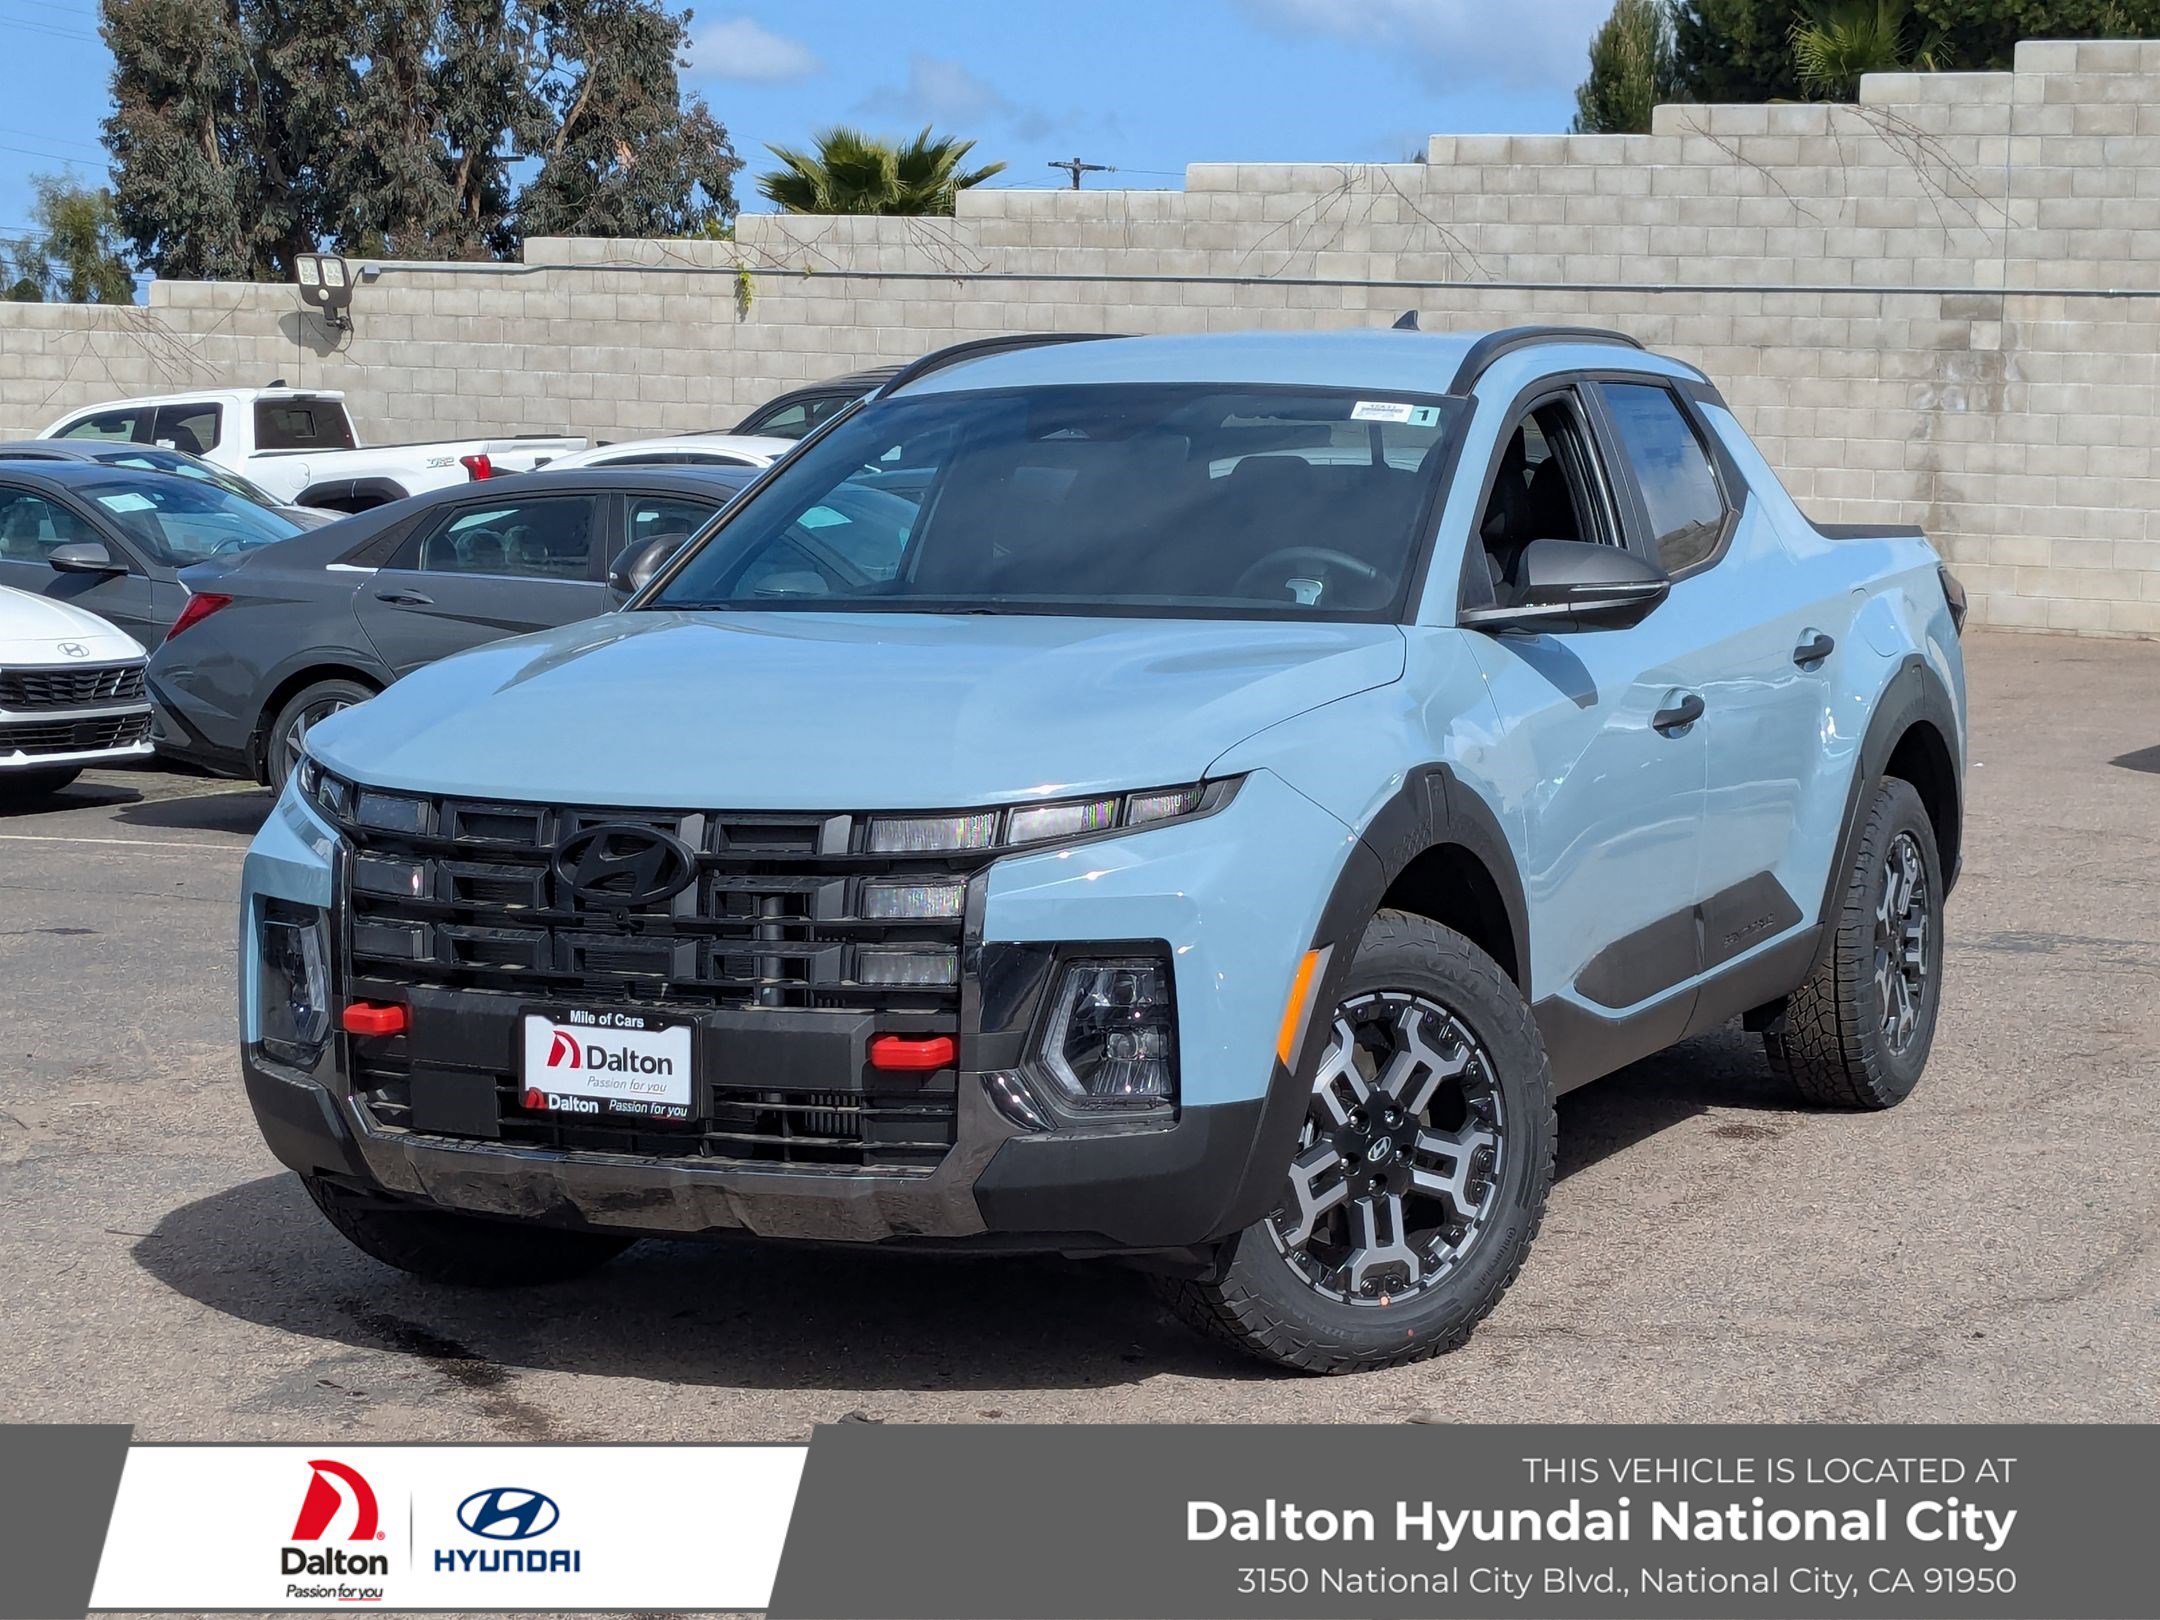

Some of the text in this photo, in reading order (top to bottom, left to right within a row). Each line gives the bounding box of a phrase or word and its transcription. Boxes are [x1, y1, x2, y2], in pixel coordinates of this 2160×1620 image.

[1417, 409, 1430, 421] 1
[569, 1009, 645, 1029] Mile of Cars
[586, 1045, 673, 1076] Dalton
[587, 1075, 668, 1094] Passion for you
[549, 1094, 688, 1118] Dalton Passion for you
